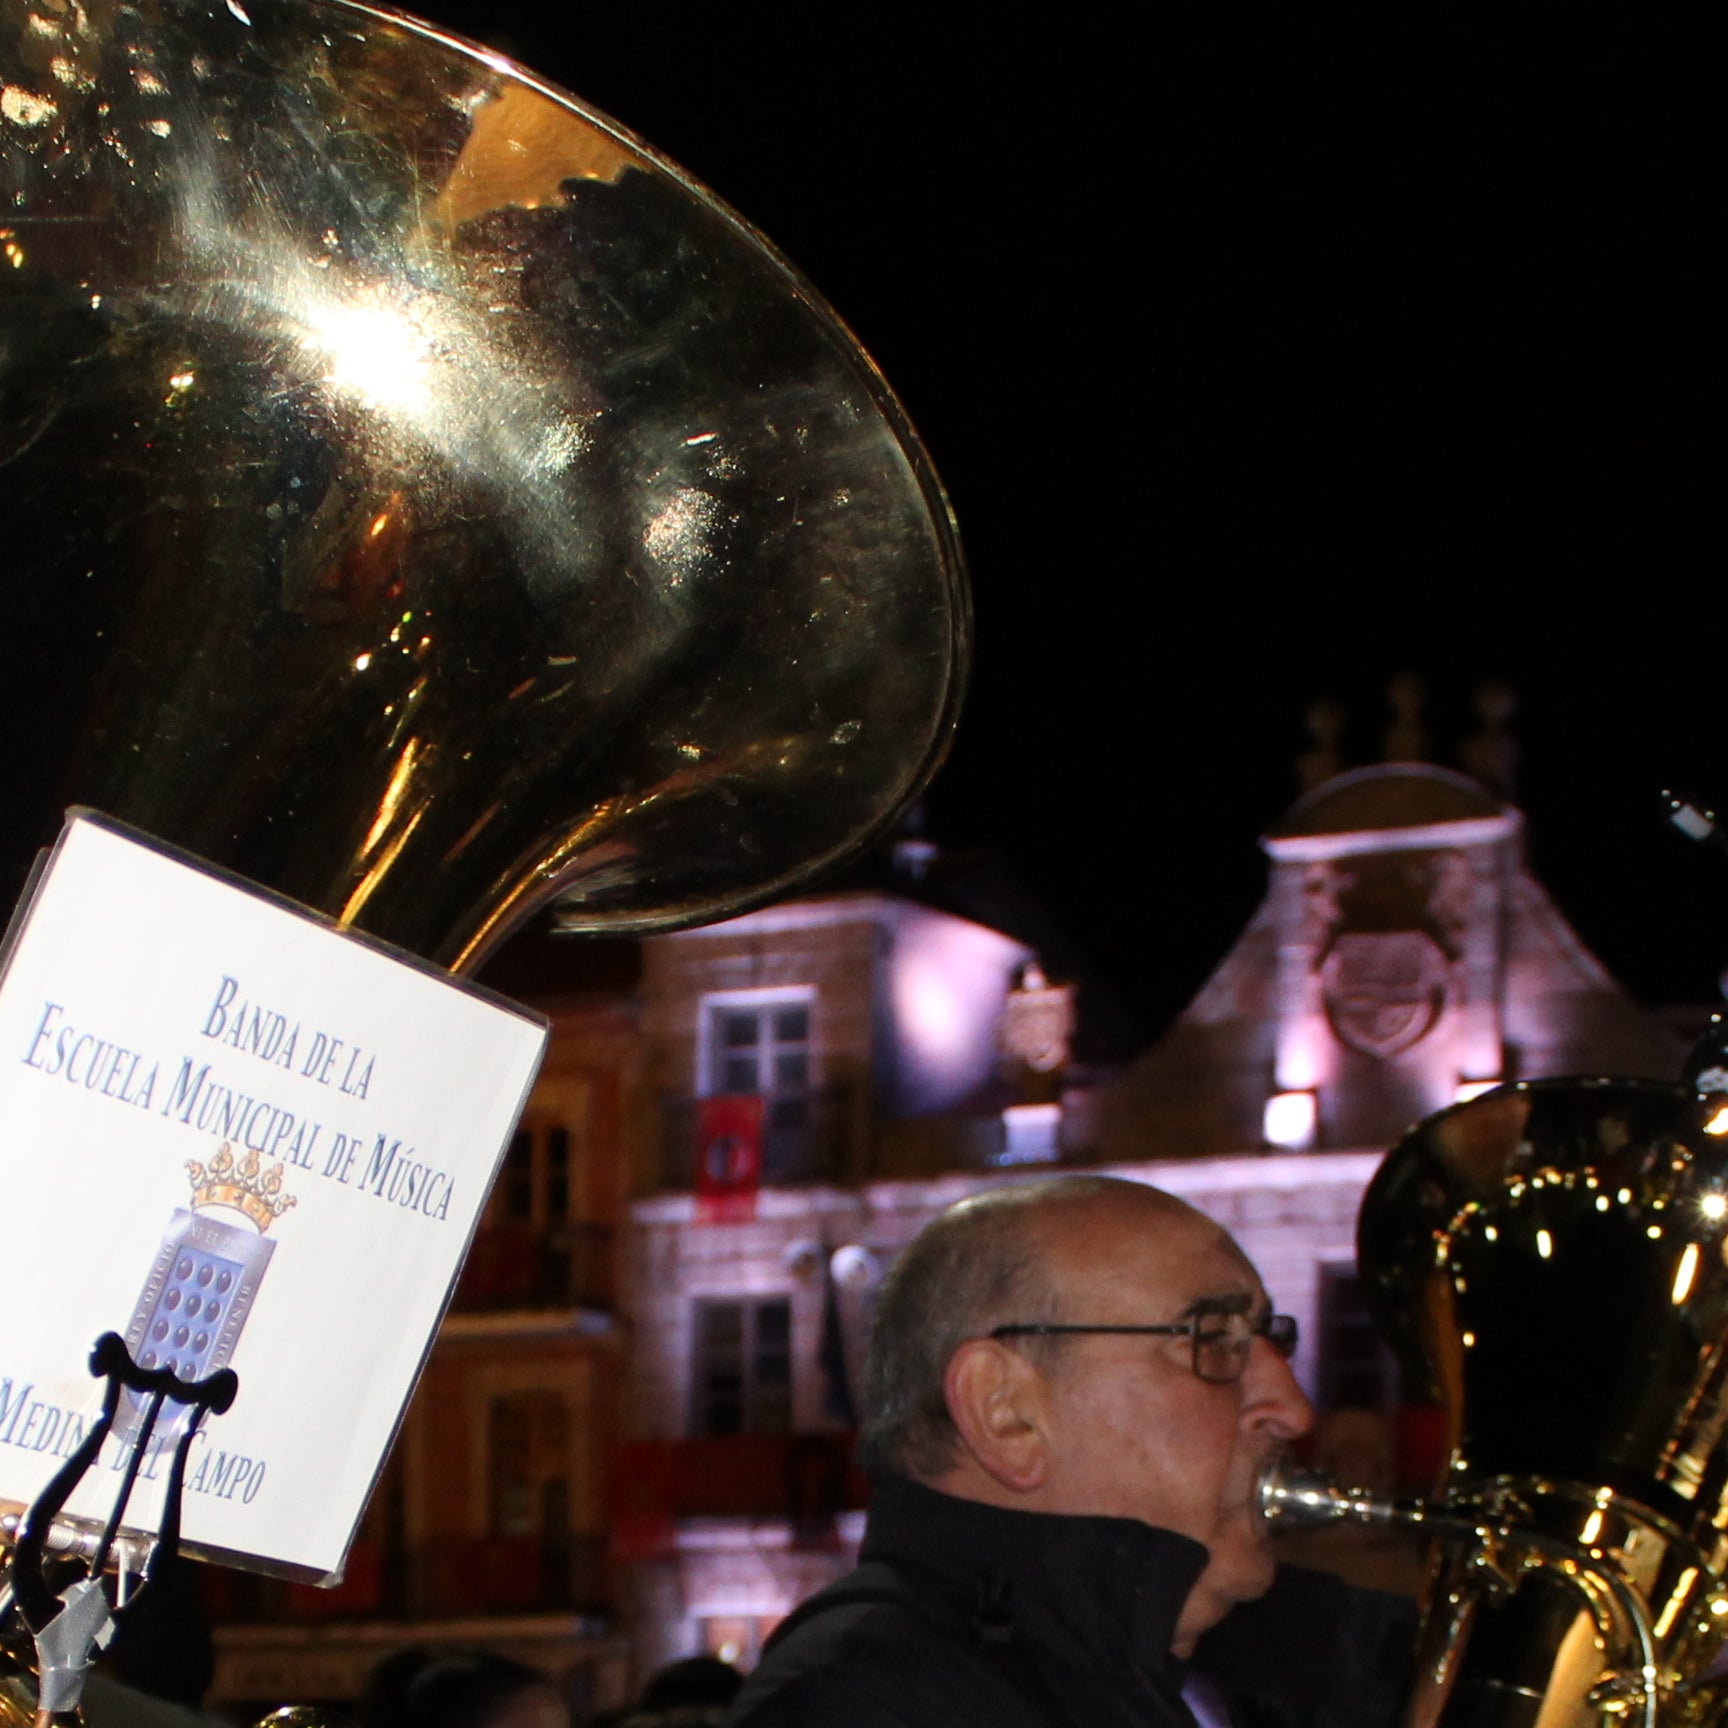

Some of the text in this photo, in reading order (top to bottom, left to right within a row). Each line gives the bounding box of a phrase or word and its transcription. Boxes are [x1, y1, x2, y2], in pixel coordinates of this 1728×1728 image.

[21, 1000, 160, 1109] ESCUELA
[161, 1056, 322, 1170] MUNICIPAL
[321, 1132, 362, 1185] DE
[201, 974, 376, 1100] BANDA DE LA
[127, 1243, 174, 1345] REY OFICIO
[213, 1285, 251, 1368] BENEFICI
